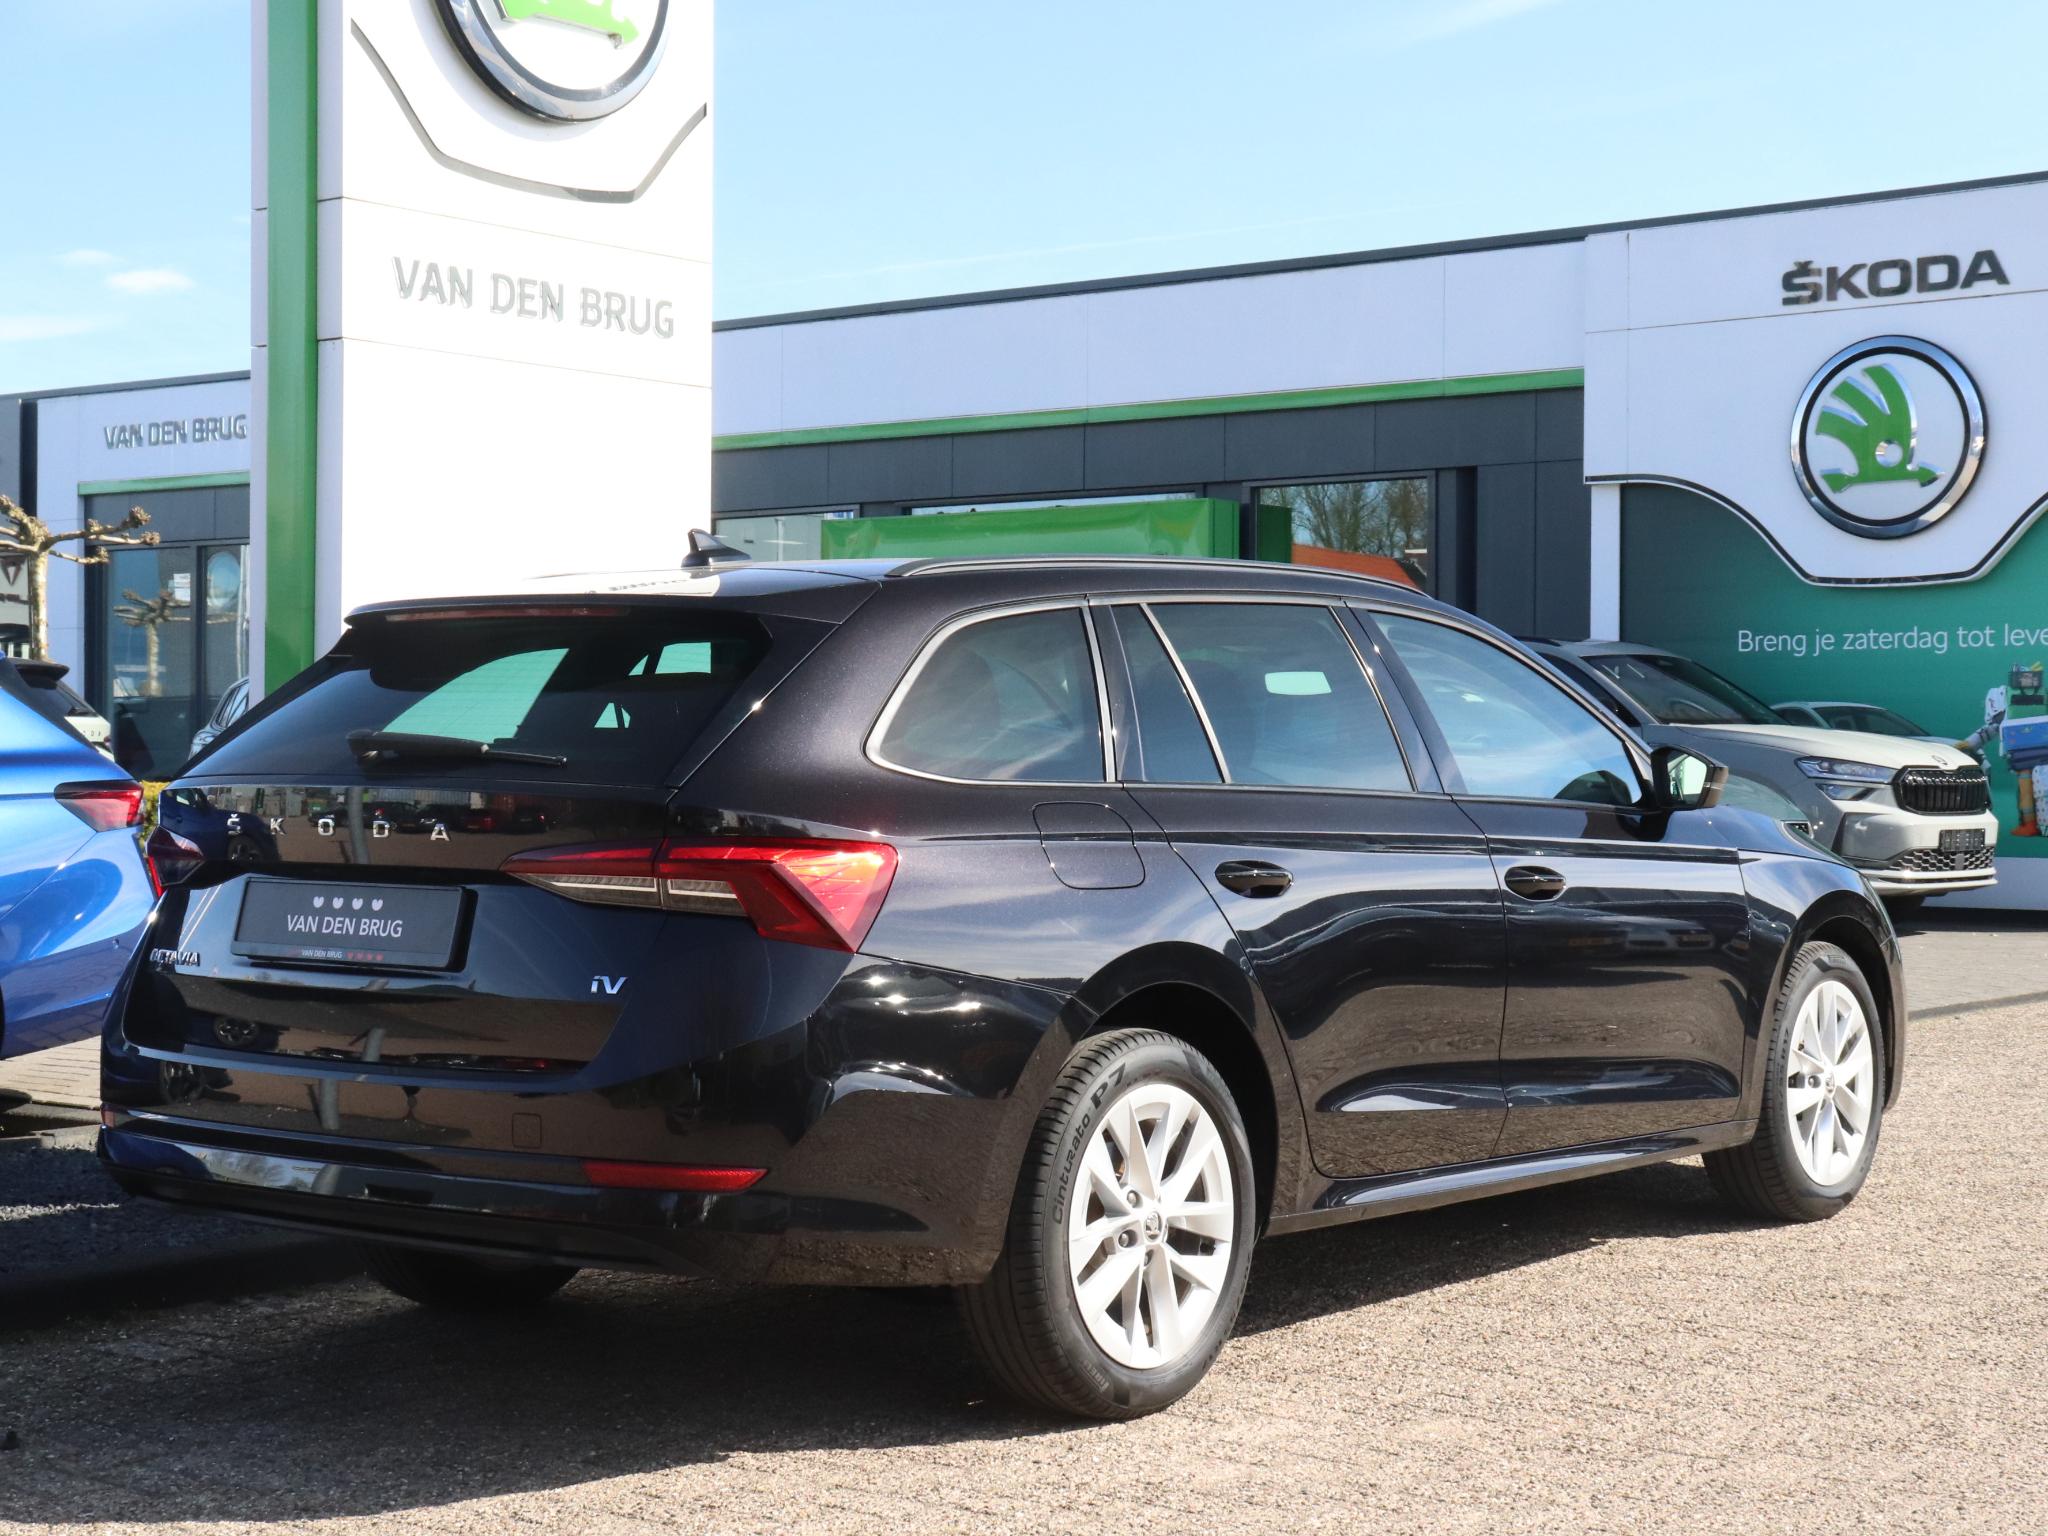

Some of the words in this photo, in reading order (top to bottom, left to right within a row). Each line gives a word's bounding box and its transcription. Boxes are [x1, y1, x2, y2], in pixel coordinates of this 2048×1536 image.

[1782, 249, 2011, 306] ŠKODA
[391, 256, 474, 309] VAN
[490, 272, 565, 322] DEN
[580, 286, 674, 339] BRUG
[104, 423, 144, 450] VAN
[148, 419, 189, 446] DEN
[192, 413, 248, 444] BRUG
[1737, 629, 1806, 657] Breng
[1812, 628, 1835, 657] je
[1842, 626, 1948, 653] zaterdag
[1956, 625, 1996, 648] tot
[287, 914, 319, 933] VAN
[322, 916, 356, 935] DEN
[359, 918, 403, 938] BRUG
[301, 949, 314, 957] VAN
[314, 950, 327, 958] DEN
[327, 951, 343, 959] BRUG
[1090, 1062, 1127, 1110] P7
